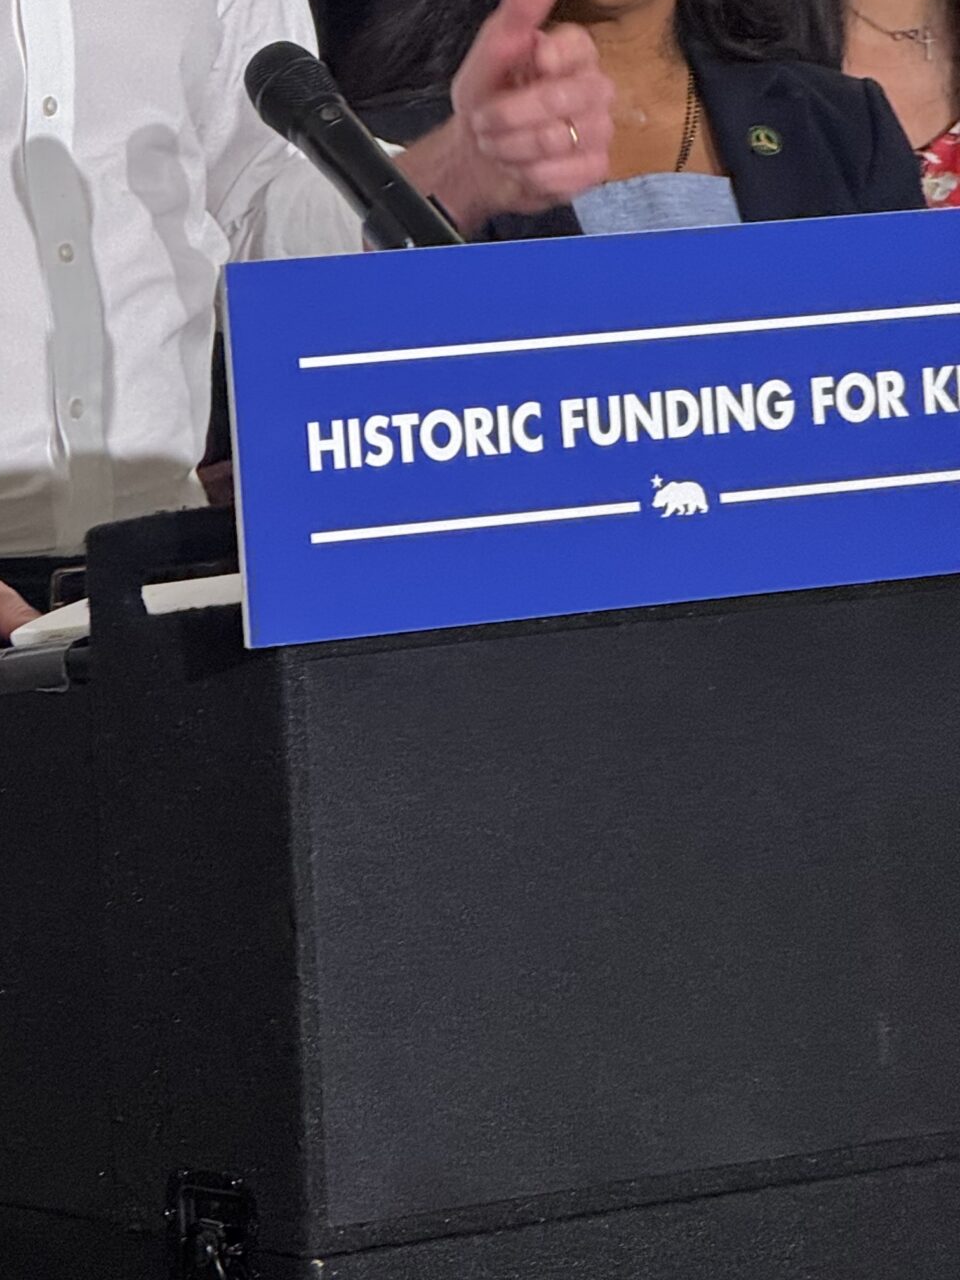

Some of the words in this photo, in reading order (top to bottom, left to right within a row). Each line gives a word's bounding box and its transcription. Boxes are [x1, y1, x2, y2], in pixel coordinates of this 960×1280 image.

[307, 401, 544, 472] HISTORIC
[560, 379, 795, 449] FUNDING
[810, 370, 910, 425] FOR
